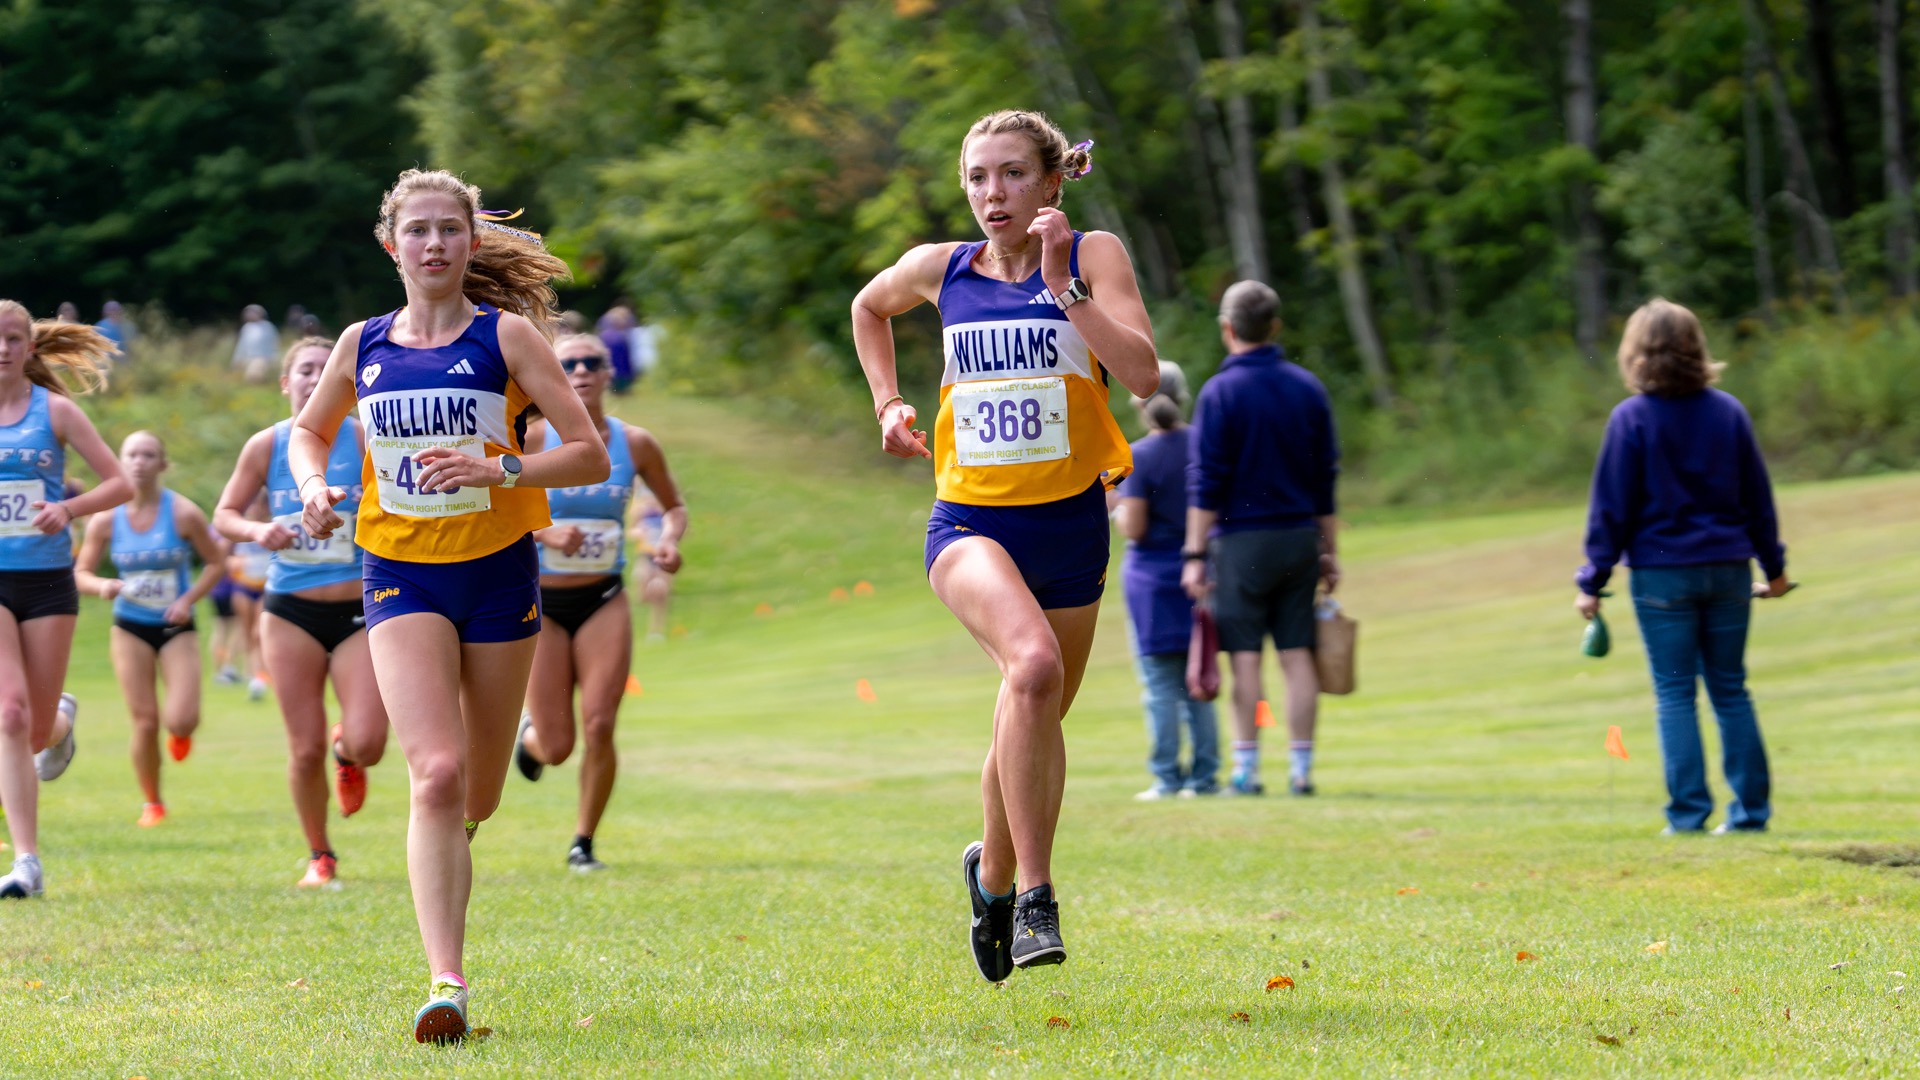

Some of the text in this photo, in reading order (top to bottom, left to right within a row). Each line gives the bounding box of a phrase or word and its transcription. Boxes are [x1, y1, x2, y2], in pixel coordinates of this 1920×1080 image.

[952, 327, 1059, 374] WILLIAMS
[366, 369, 377, 378] AK
[990, 384, 1020, 393] VALLEY
[1021, 381, 1058, 391] CLASSIC
[369, 396, 478, 437] WILLIAMS
[977, 398, 1042, 443] 368
[375, 439, 475, 450] PURPLE VALLEY CLASSIC
[968, 446, 1057, 460] FINISH RIGHT TIMING
[396, 456, 461, 496] 42
[390, 501, 477, 513] FINISH RIGHT TIMING
[373, 587, 400, 603] Ephs
